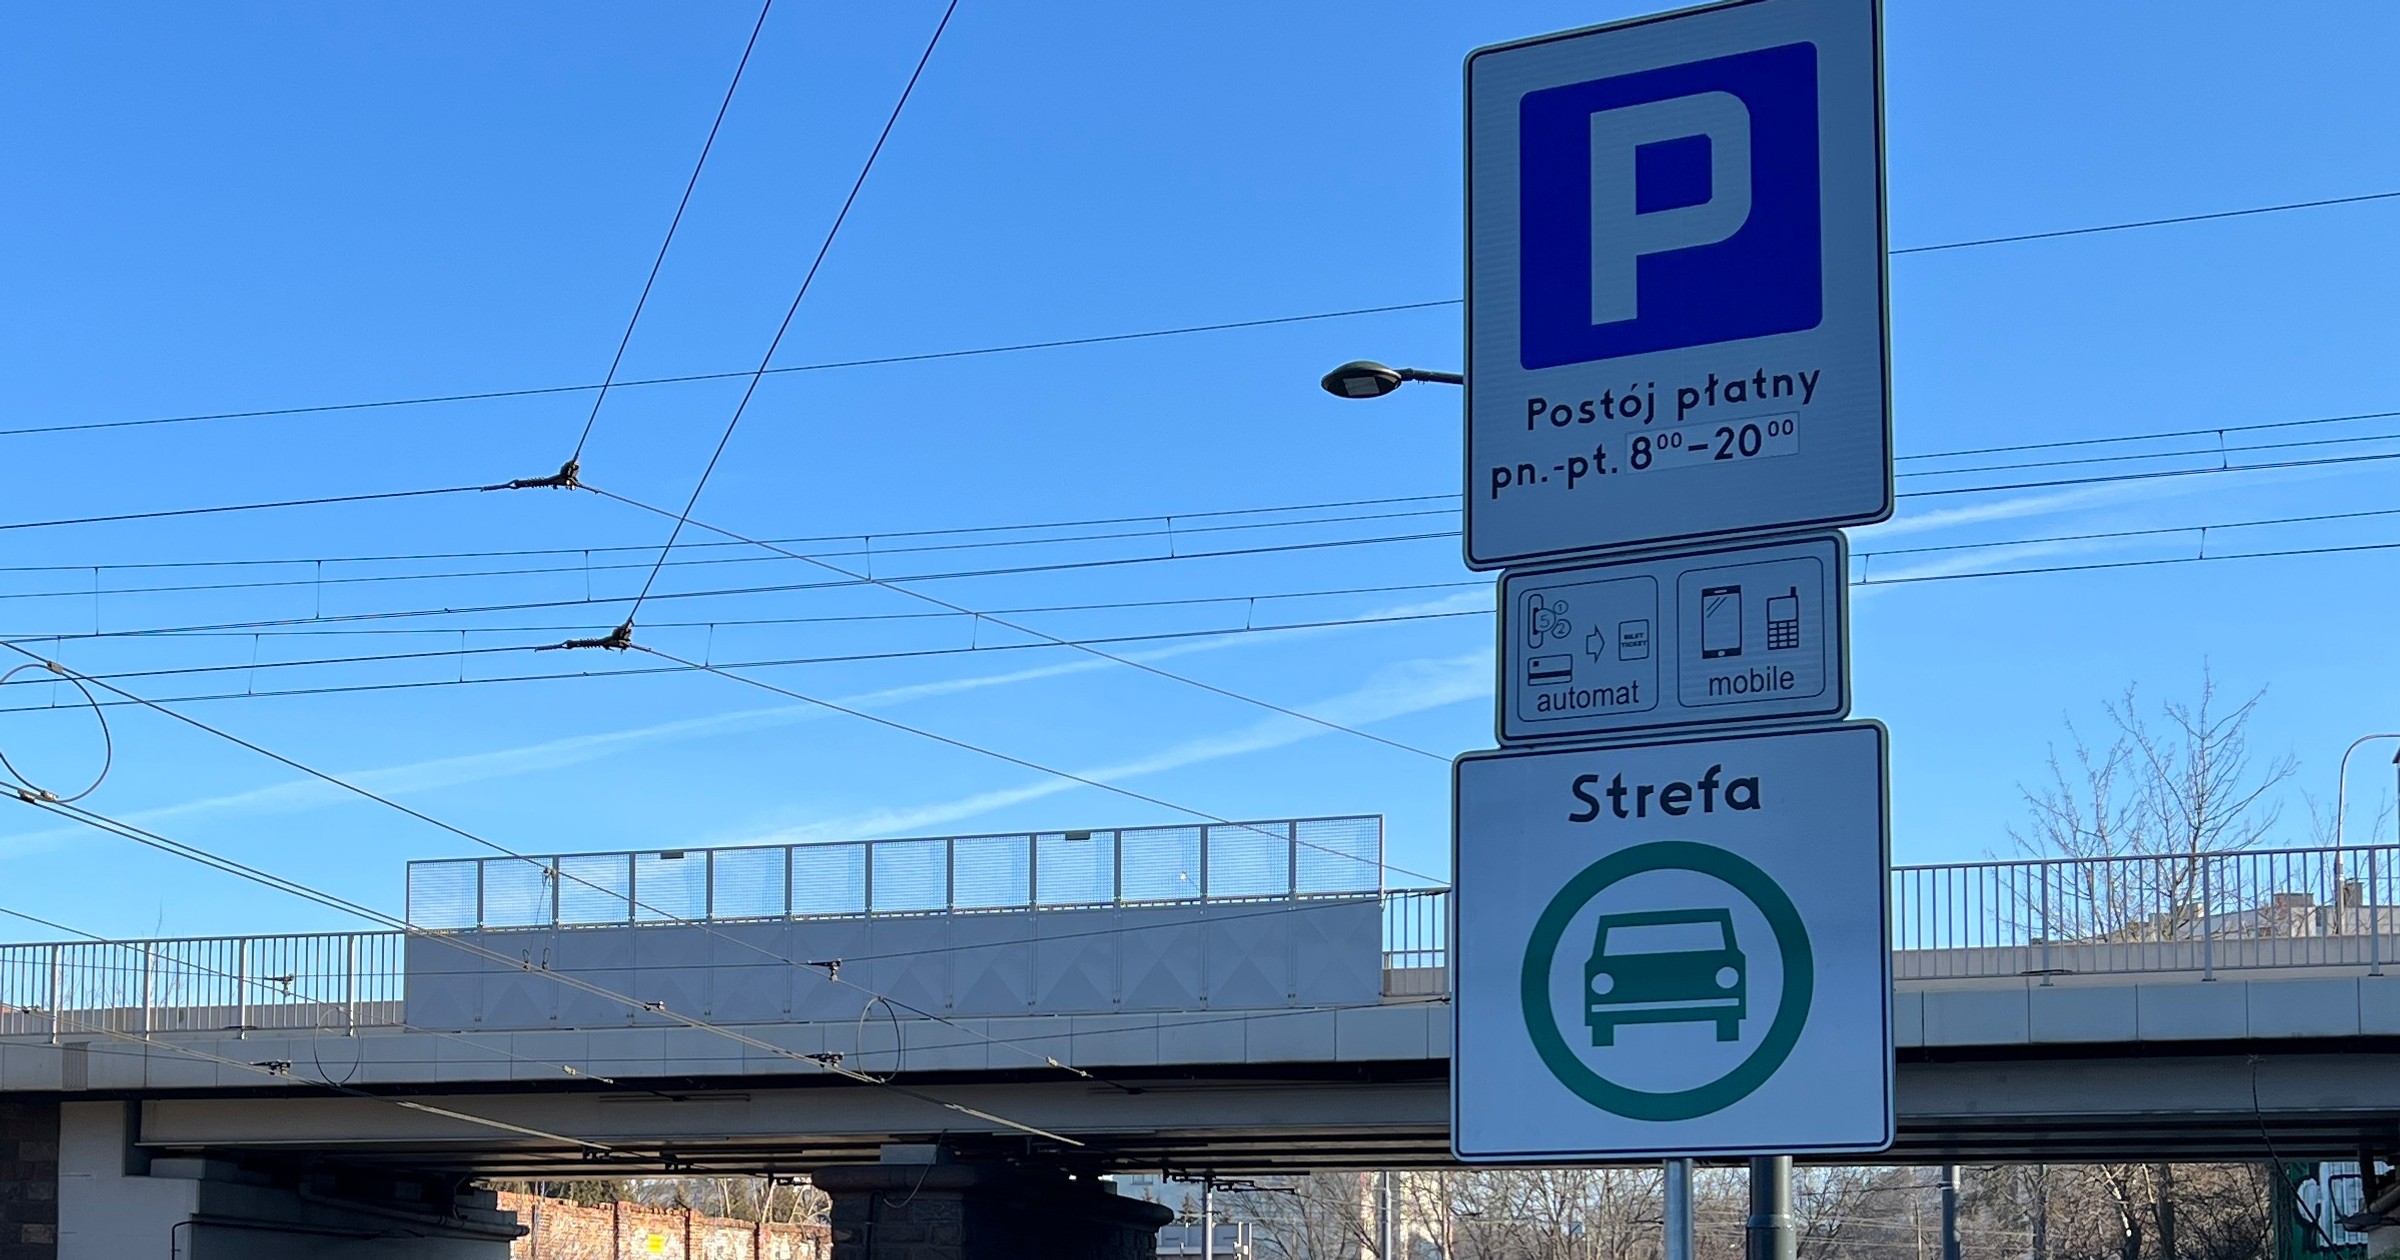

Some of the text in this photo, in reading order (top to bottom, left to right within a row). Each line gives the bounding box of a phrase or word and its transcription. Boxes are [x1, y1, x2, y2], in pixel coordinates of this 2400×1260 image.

[1590, 90, 1752, 326] P
[1527, 367, 1821, 431] Postój płatny
[1491, 443, 1618, 499] pn.-pt.
[1537, 680, 1640, 712] automat
[1708, 665, 1795, 697] mobile
[1568, 764, 1762, 823] Strefa
